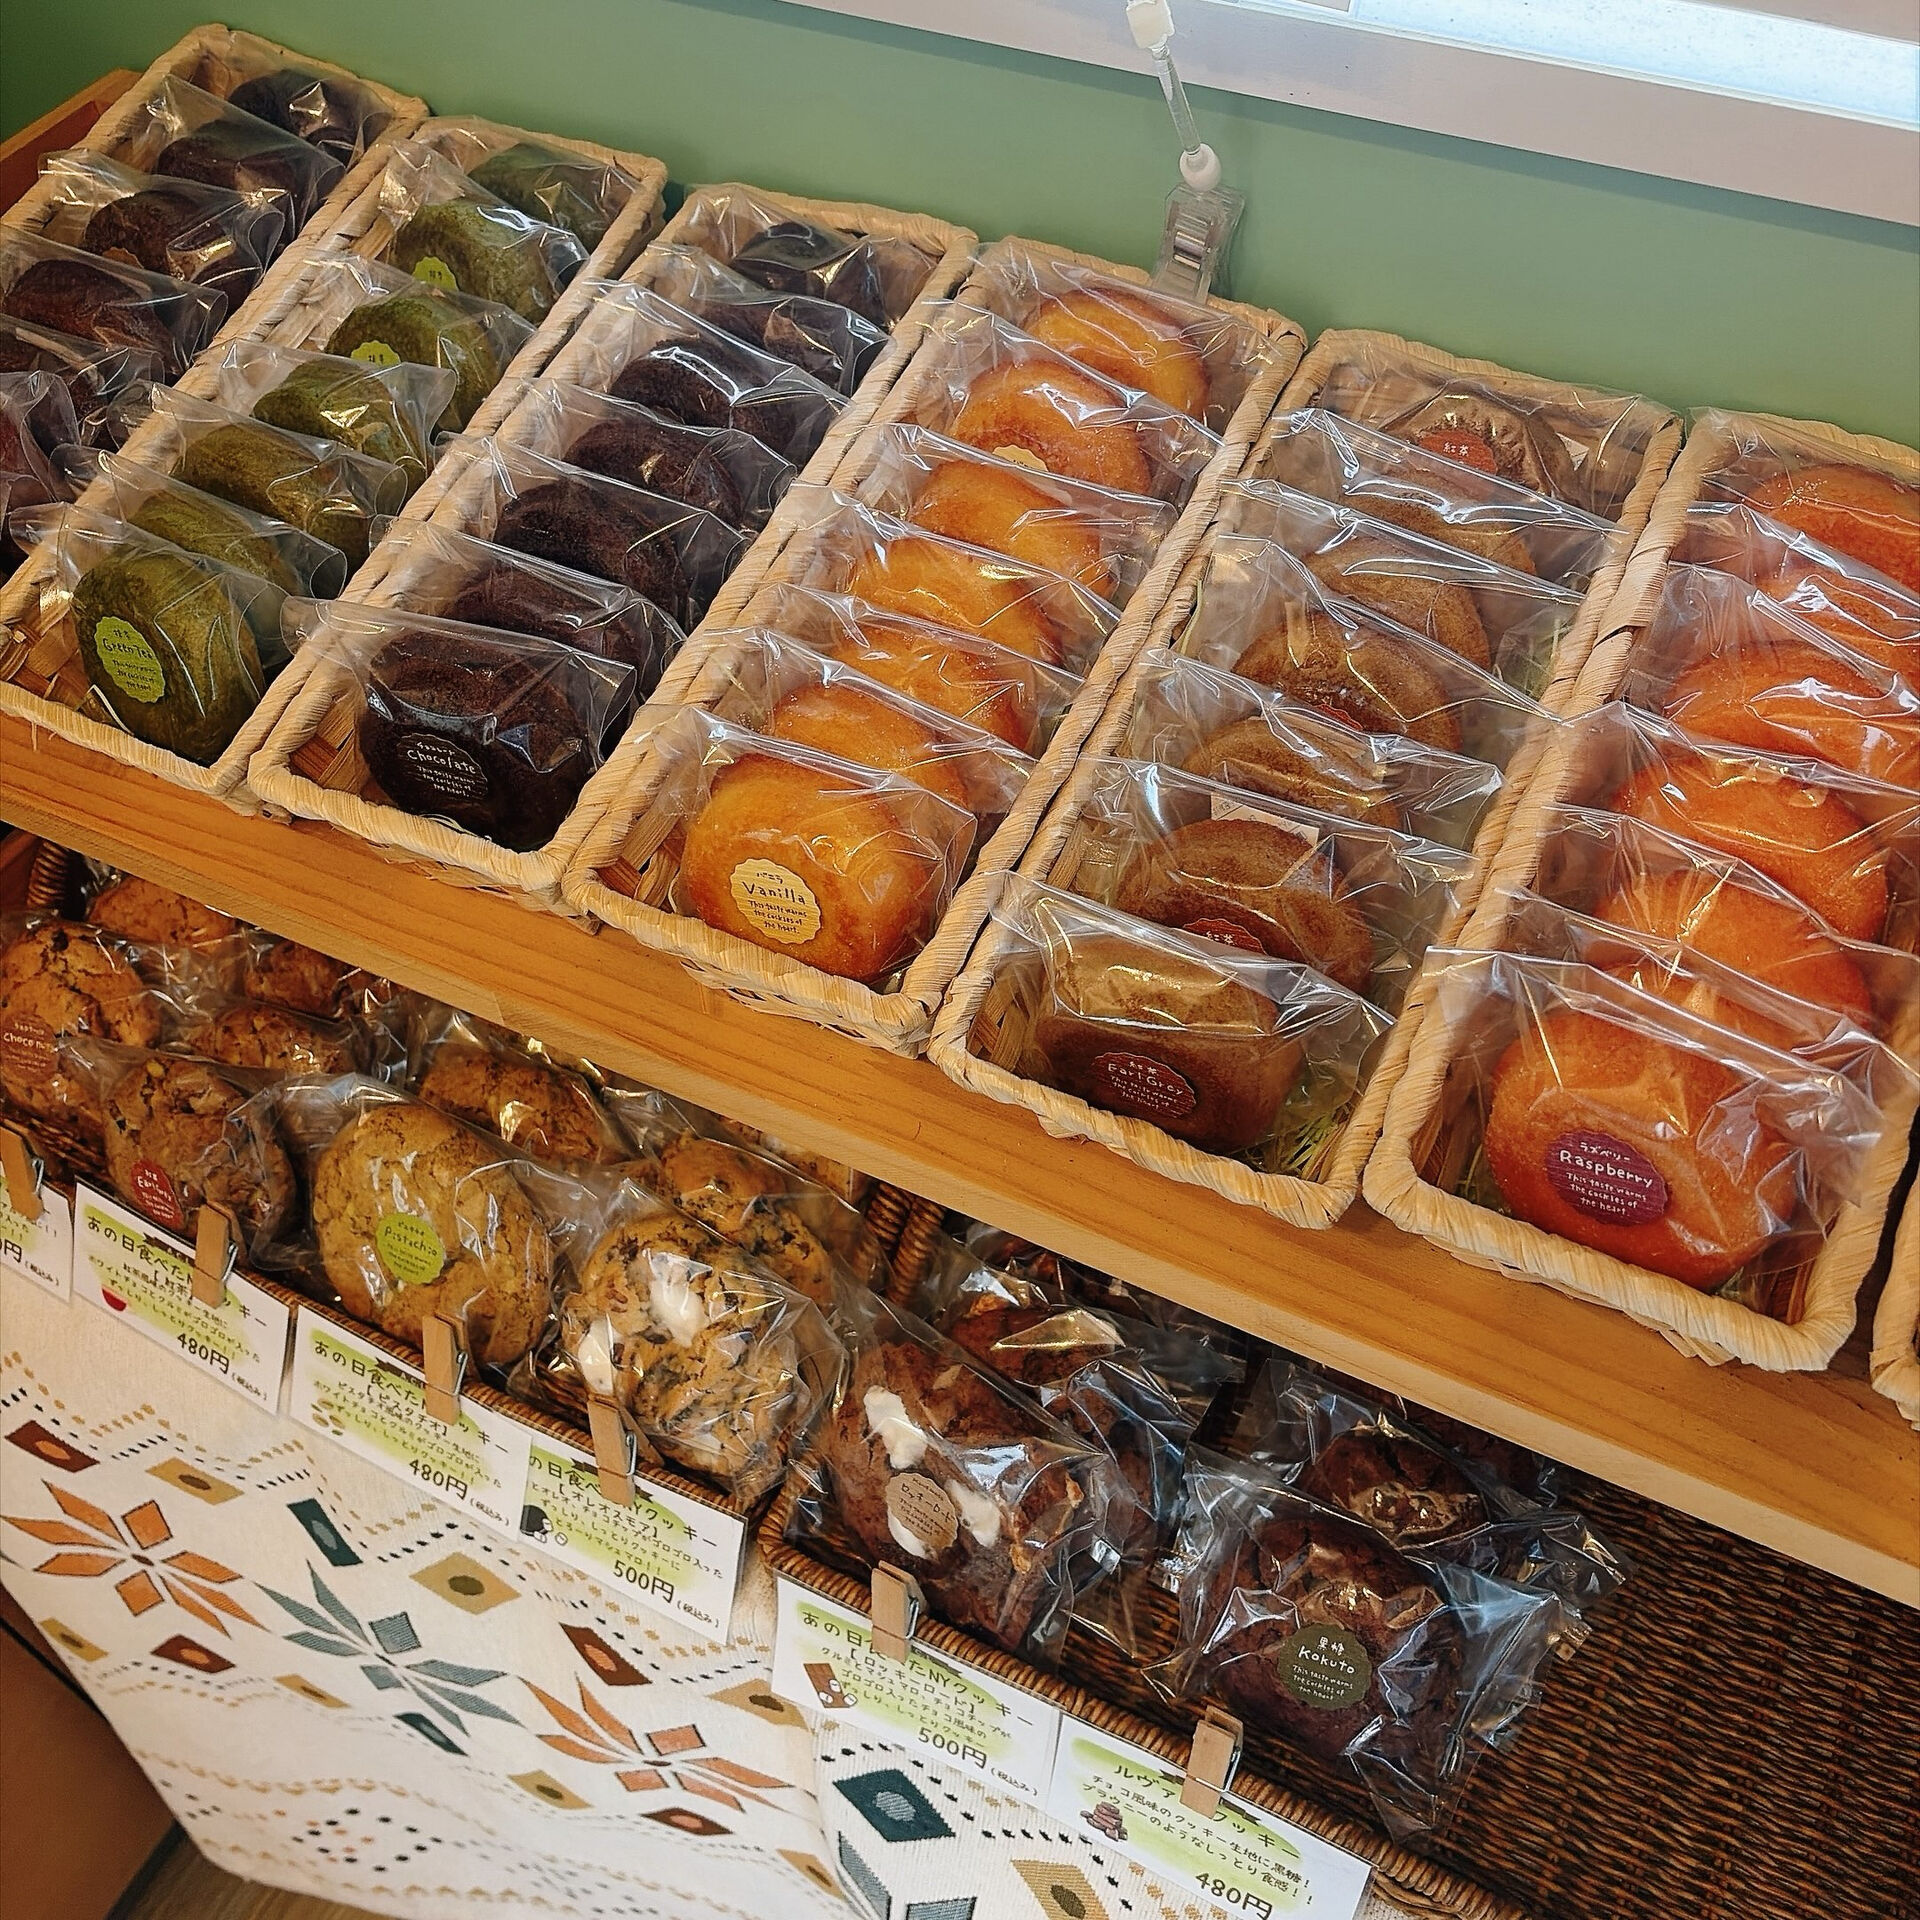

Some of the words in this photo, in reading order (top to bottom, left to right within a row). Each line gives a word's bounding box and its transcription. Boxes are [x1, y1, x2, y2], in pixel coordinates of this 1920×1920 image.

[407, 749, 476, 774] Chocolate
[742, 881, 806, 905] Vanilla
[1560, 1150, 1653, 1188] Raspberry
[1580, 1141, 1631, 1162] ラズベリー
[1566, 1172, 1587, 1184] This
[1590, 1179, 1614, 1192] taste
[1616, 1187, 1647, 1202] warms
[1570, 1184, 1586, 1194] the
[1627, 1201, 1638, 1209] of
[1580, 1197, 1596, 1207] the
[0, 1238, 22, 1263] 円
[87, 1215, 268, 1327] あの日食べたッキー
[177, 1333, 230, 1374] 480円
[314, 1340, 510, 1453] あの日食べたッキー
[409, 1459, 468, 1500] 480円
[613, 1560, 674, 1603] 500円
[1298, 1645, 1355, 1674] Kokuto
[1317, 1636, 1345, 1656] 黒糖
[802, 1611, 1033, 1726] あの日たNYクッキー
[850, 1648, 975, 1714] 【ロッキーロード】
[918, 1727, 988, 1769] 500円
[1092, 1774, 1310, 1889] チョコ風味のクッキー生地に黒糖！
[1114, 1765, 1300, 1859] ルヴァクッキー
[1195, 1872, 1273, 1920] 480円
